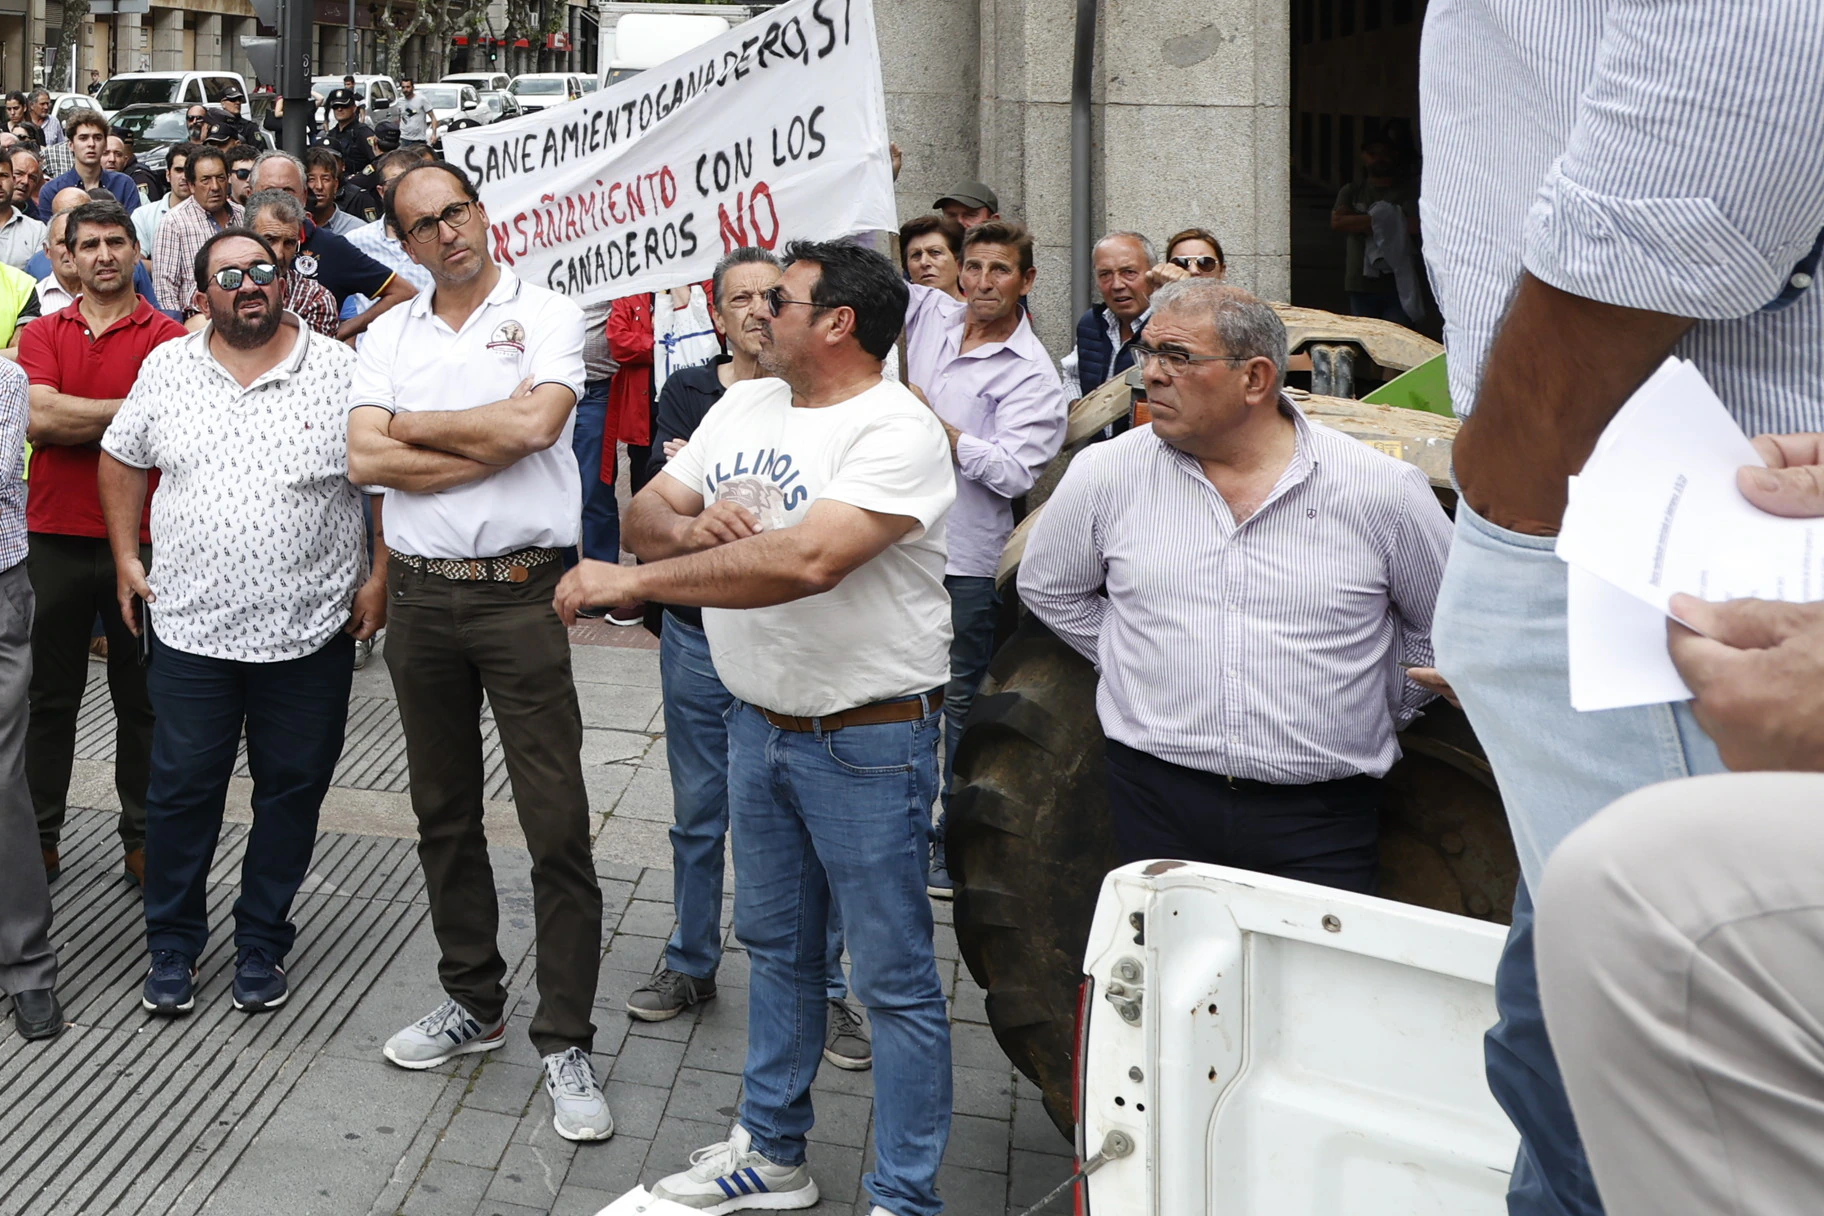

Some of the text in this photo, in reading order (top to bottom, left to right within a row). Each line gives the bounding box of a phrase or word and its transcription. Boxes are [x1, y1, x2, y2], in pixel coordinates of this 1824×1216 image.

[491, 105, 826, 267] NSAÑAMIENTO CON LOS
[547, 180, 780, 295] GANADEROS NO
[705, 447, 808, 512] ILLINOIS
